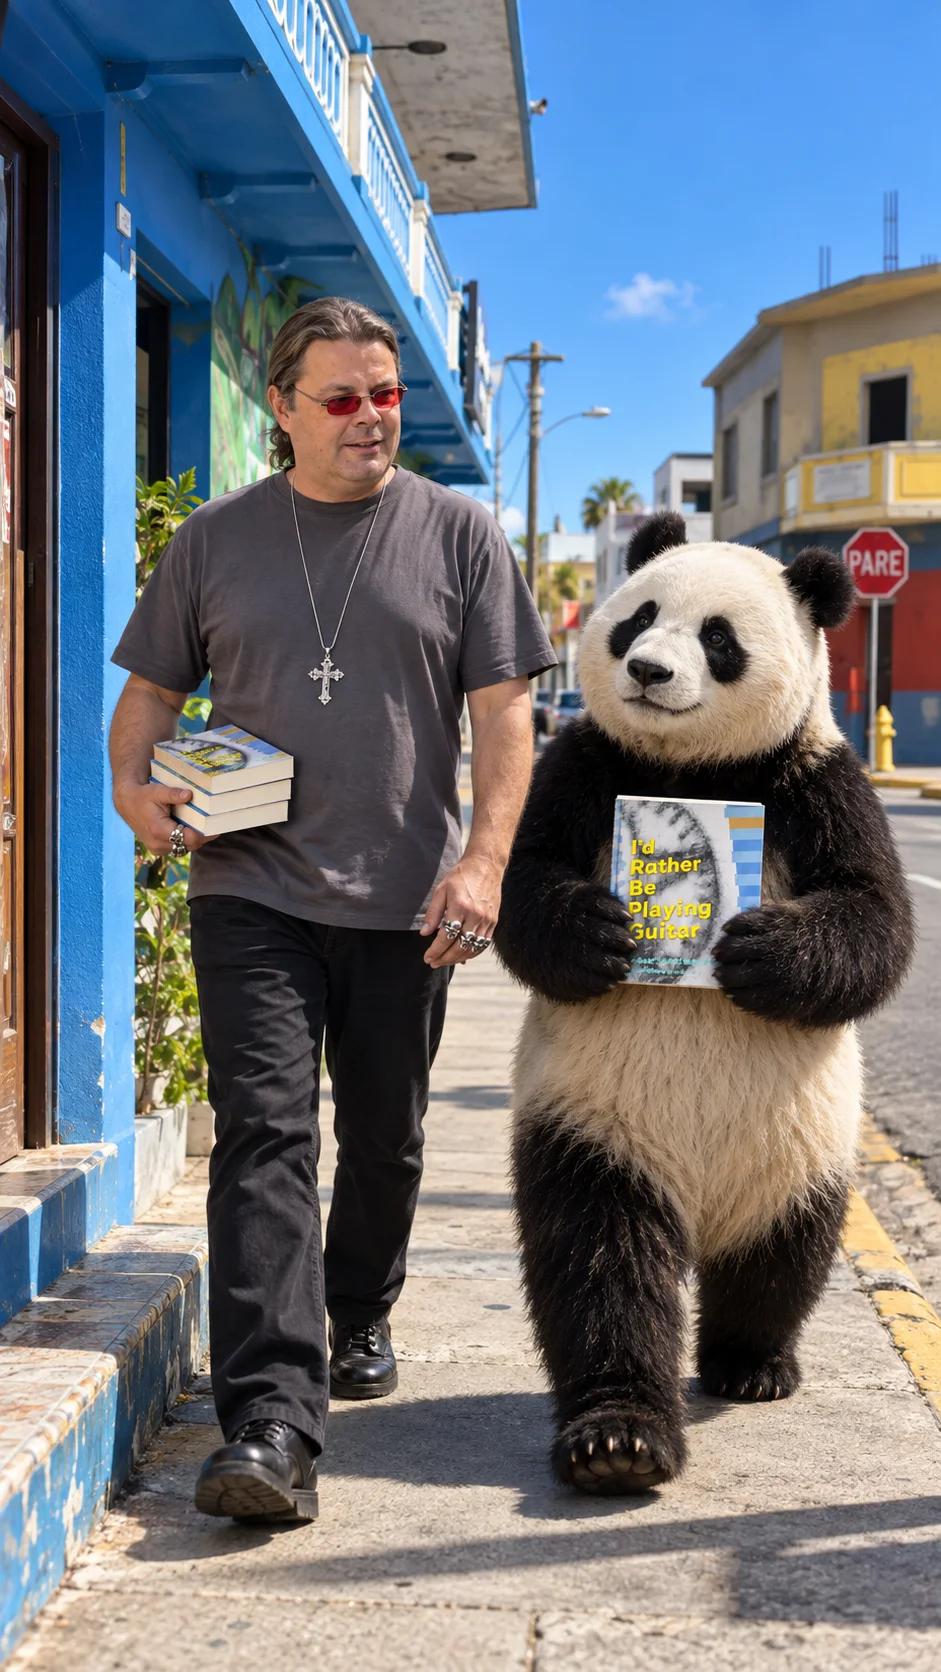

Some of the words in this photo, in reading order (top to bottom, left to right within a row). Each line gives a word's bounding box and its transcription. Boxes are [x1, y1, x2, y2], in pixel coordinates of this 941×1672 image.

[849, 550, 902, 577] PARE
[631, 839, 656, 855] I'd
[630, 857, 701, 875] Rather
[629, 880, 657, 896] Be
[628, 900, 712, 920] Playing
[629, 922, 701, 940] Guitar
